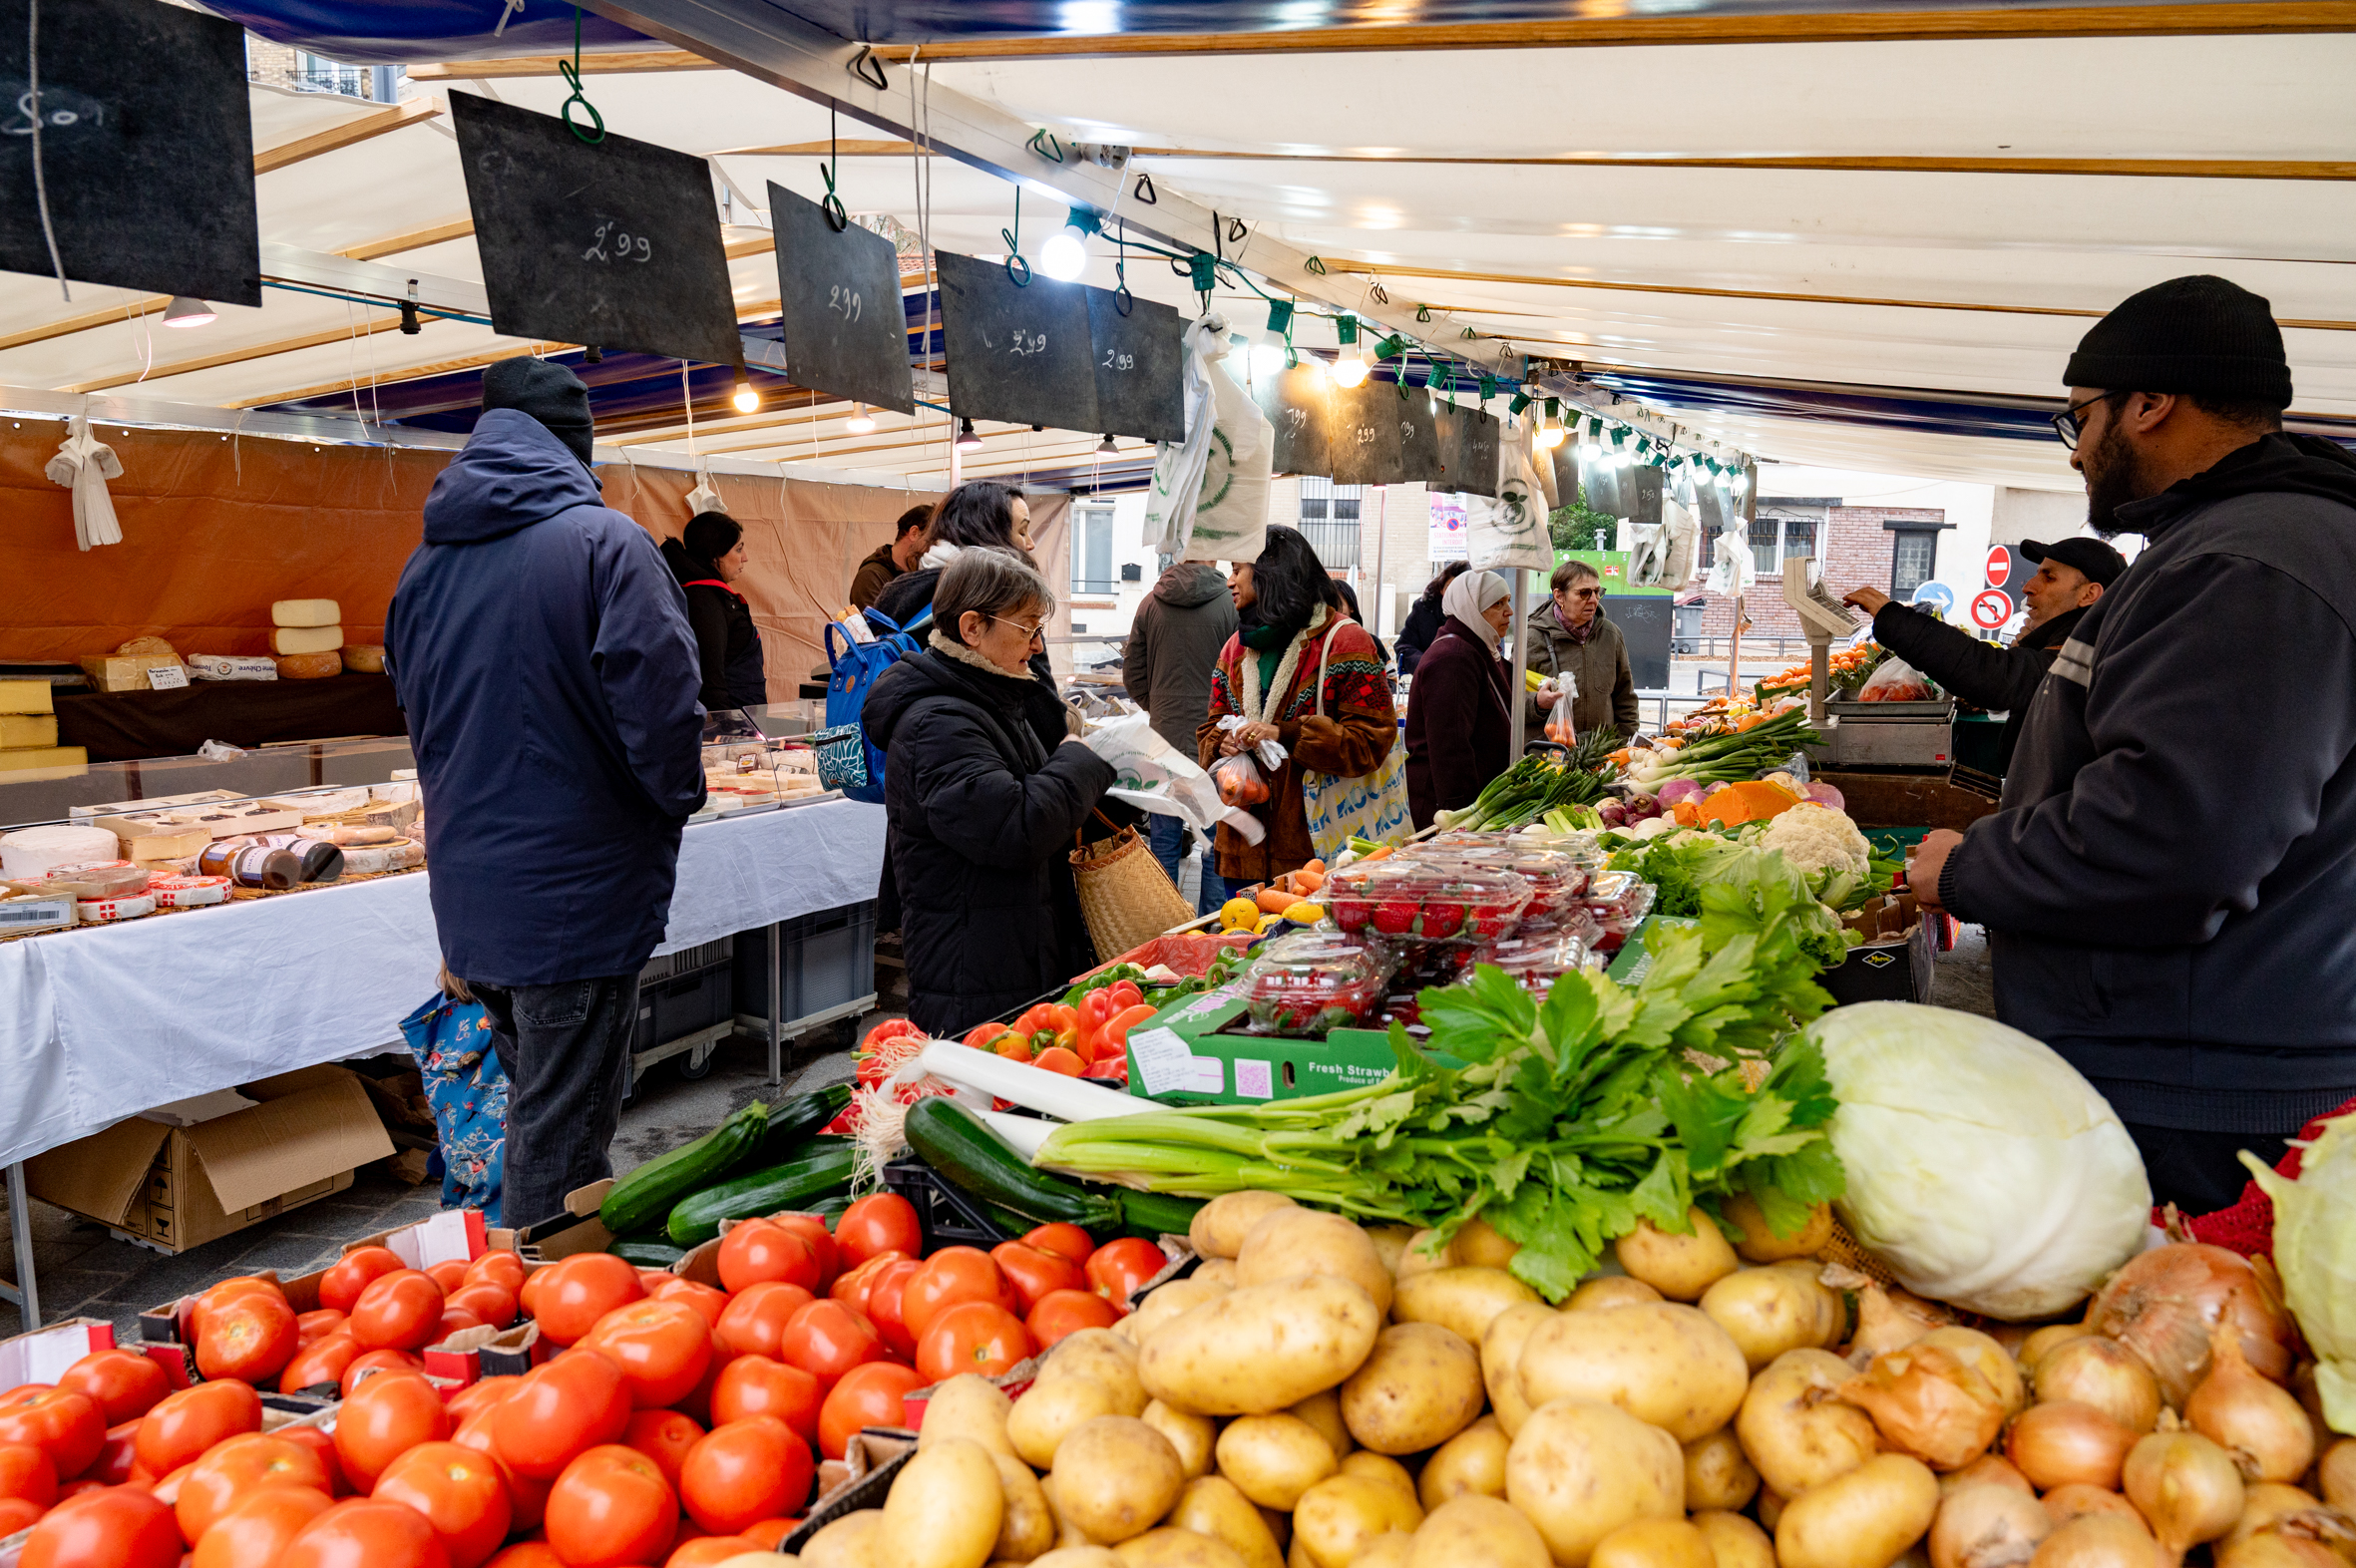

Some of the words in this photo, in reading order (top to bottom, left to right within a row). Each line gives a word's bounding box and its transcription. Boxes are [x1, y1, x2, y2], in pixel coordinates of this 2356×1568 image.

[1309, 1062, 1343, 1074] Fresh
[1348, 1065, 1390, 1077] Strawb
[1339, 1075, 1366, 1084] Produce
